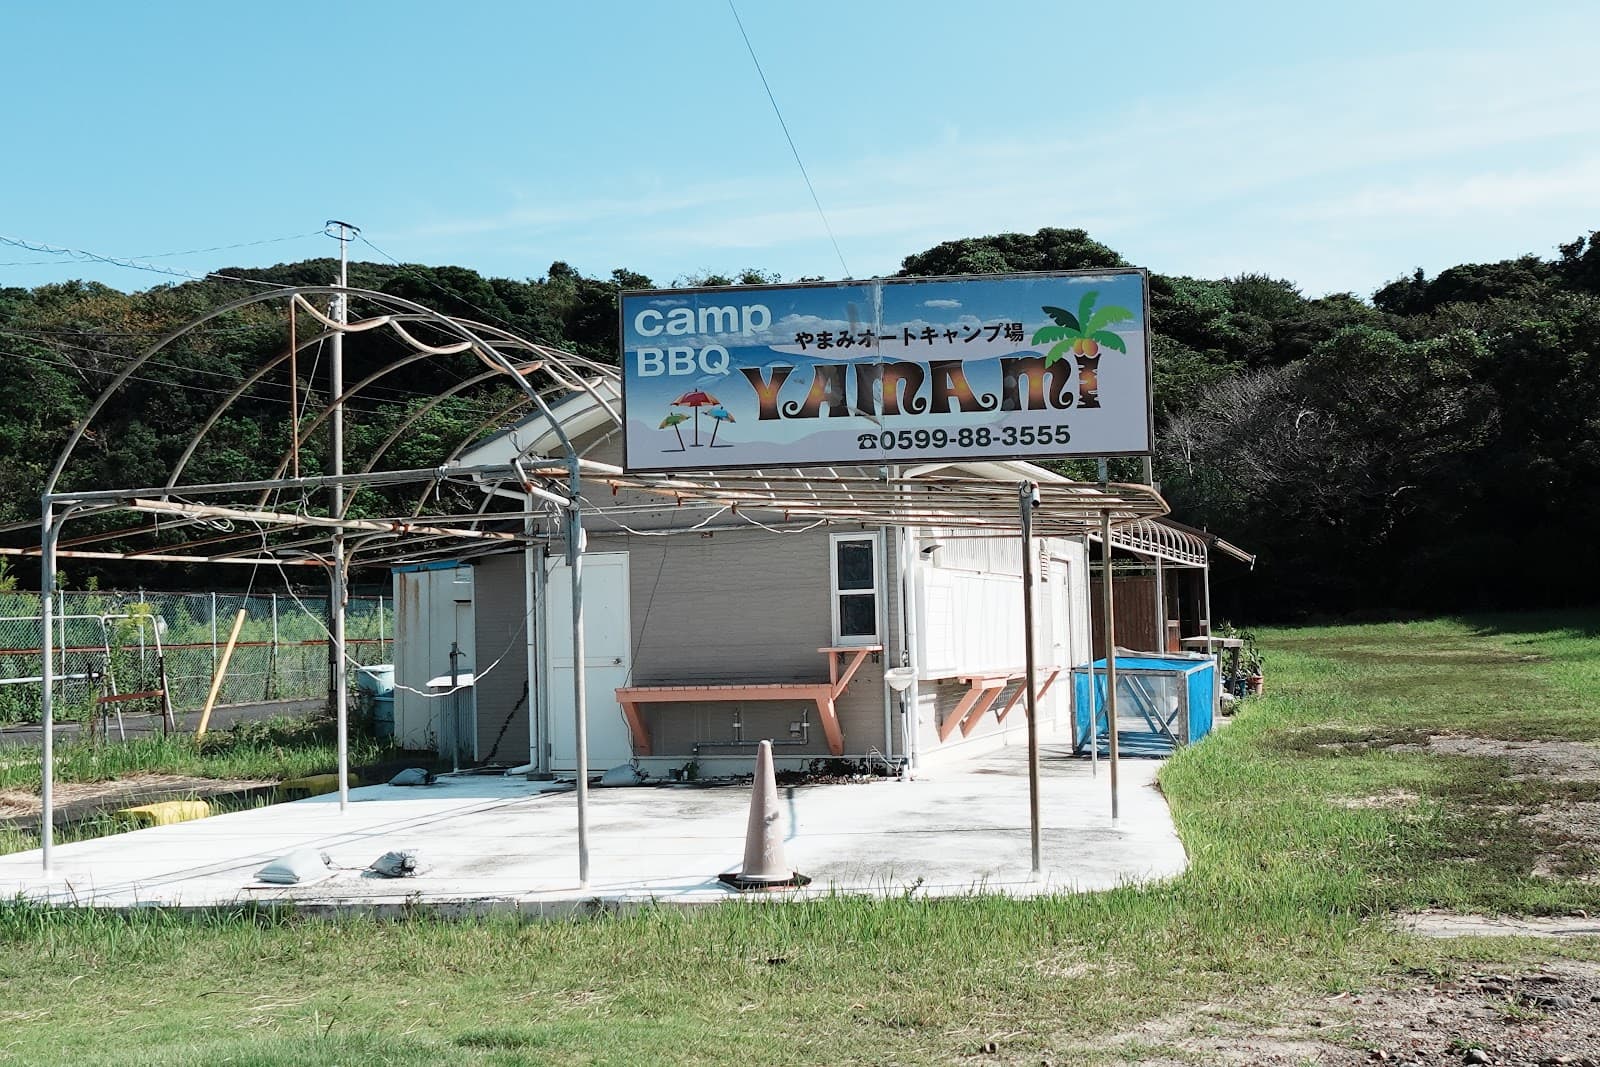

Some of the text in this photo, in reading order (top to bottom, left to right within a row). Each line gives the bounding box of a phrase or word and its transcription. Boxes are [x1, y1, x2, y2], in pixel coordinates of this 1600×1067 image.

[634, 304, 772, 337] camp
[795, 323, 1024, 350] やまみオートキャンプ場
[637, 344, 731, 377] BBQ
[880, 425, 1071, 450] 0599-88-3555
